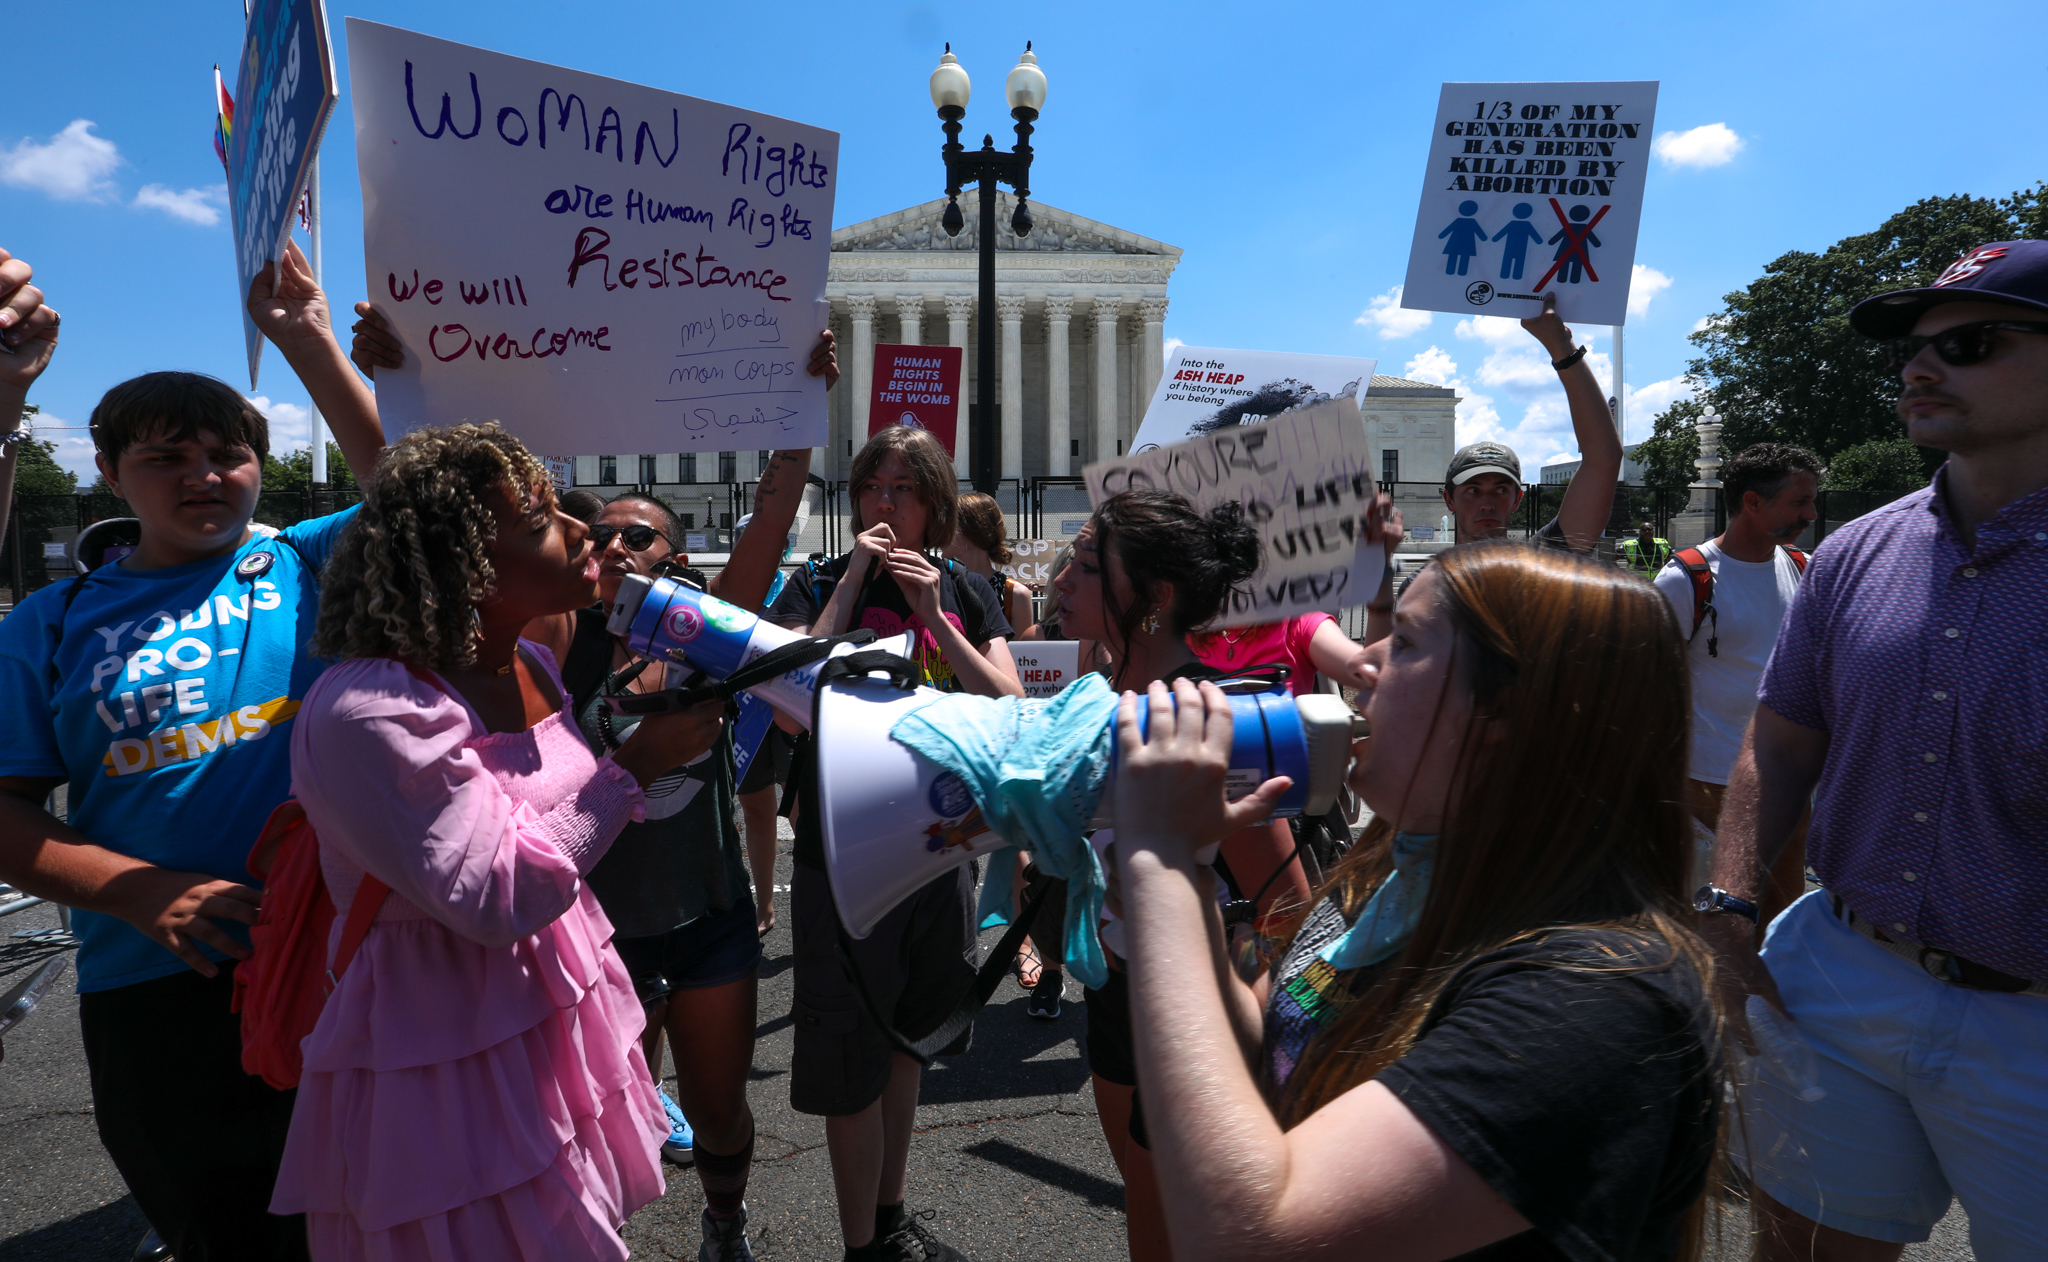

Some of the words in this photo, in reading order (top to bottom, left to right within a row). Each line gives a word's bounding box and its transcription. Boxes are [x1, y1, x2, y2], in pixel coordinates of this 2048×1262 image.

[236, 0, 296, 238] Democra
[1473, 101, 1513, 120] 1/3
[1520, 104, 1561, 121] OF
[1568, 104, 1623, 121] MY
[1445, 121, 1641, 139] GENERATION
[243, 20, 300, 278] standing
[1461, 139, 1525, 155] HAS
[1532, 140, 1616, 157] BEEN
[268, 117, 297, 221] life
[722, 122, 828, 197] Rights
[1447, 157, 1566, 176] KILLED
[1576, 160, 1625, 178] BY
[1446, 175, 1615, 197] ABORTION
[626, 188, 713, 233] Human
[727, 197, 812, 248] Rights
[567, 226, 792, 302] Resistance
[459, 274, 528, 306] will
[680, 317, 716, 348] my
[720, 307, 781, 343] body
[893, 357, 942, 369] HUMAN
[1180, 358, 1203, 369] Into
[1205, 359, 1225, 370] the
[668, 365, 724, 385] mon
[893, 369, 940, 380] RIGHTS
[1173, 370, 1203, 382] ASH
[1205, 372, 1245, 385] HEAP
[888, 381, 927, 392] BEGIN
[929, 382, 943, 392] IN
[1168, 381, 1181, 391] of
[1182, 383, 1218, 397] history
[1219, 386, 1254, 397] where
[879, 392, 903, 403] THE
[907, 393, 951, 405] WOMB
[1164, 392, 1186, 402] you
[1187, 394, 1225, 407] belong
[551, 464, 565, 472] ANY
[551, 471, 565, 479] TIME
[992, 562, 1050, 581] ACK
[94, 581, 281, 654] YOUNG
[90, 637, 239, 693] PRO-
[1018, 656, 1038, 667] the
[1024, 669, 1062, 683] HEAP
[1042, 684, 1065, 694] whe
[95, 678, 209, 734] LIFE
[108, 705, 271, 776] DEMS
